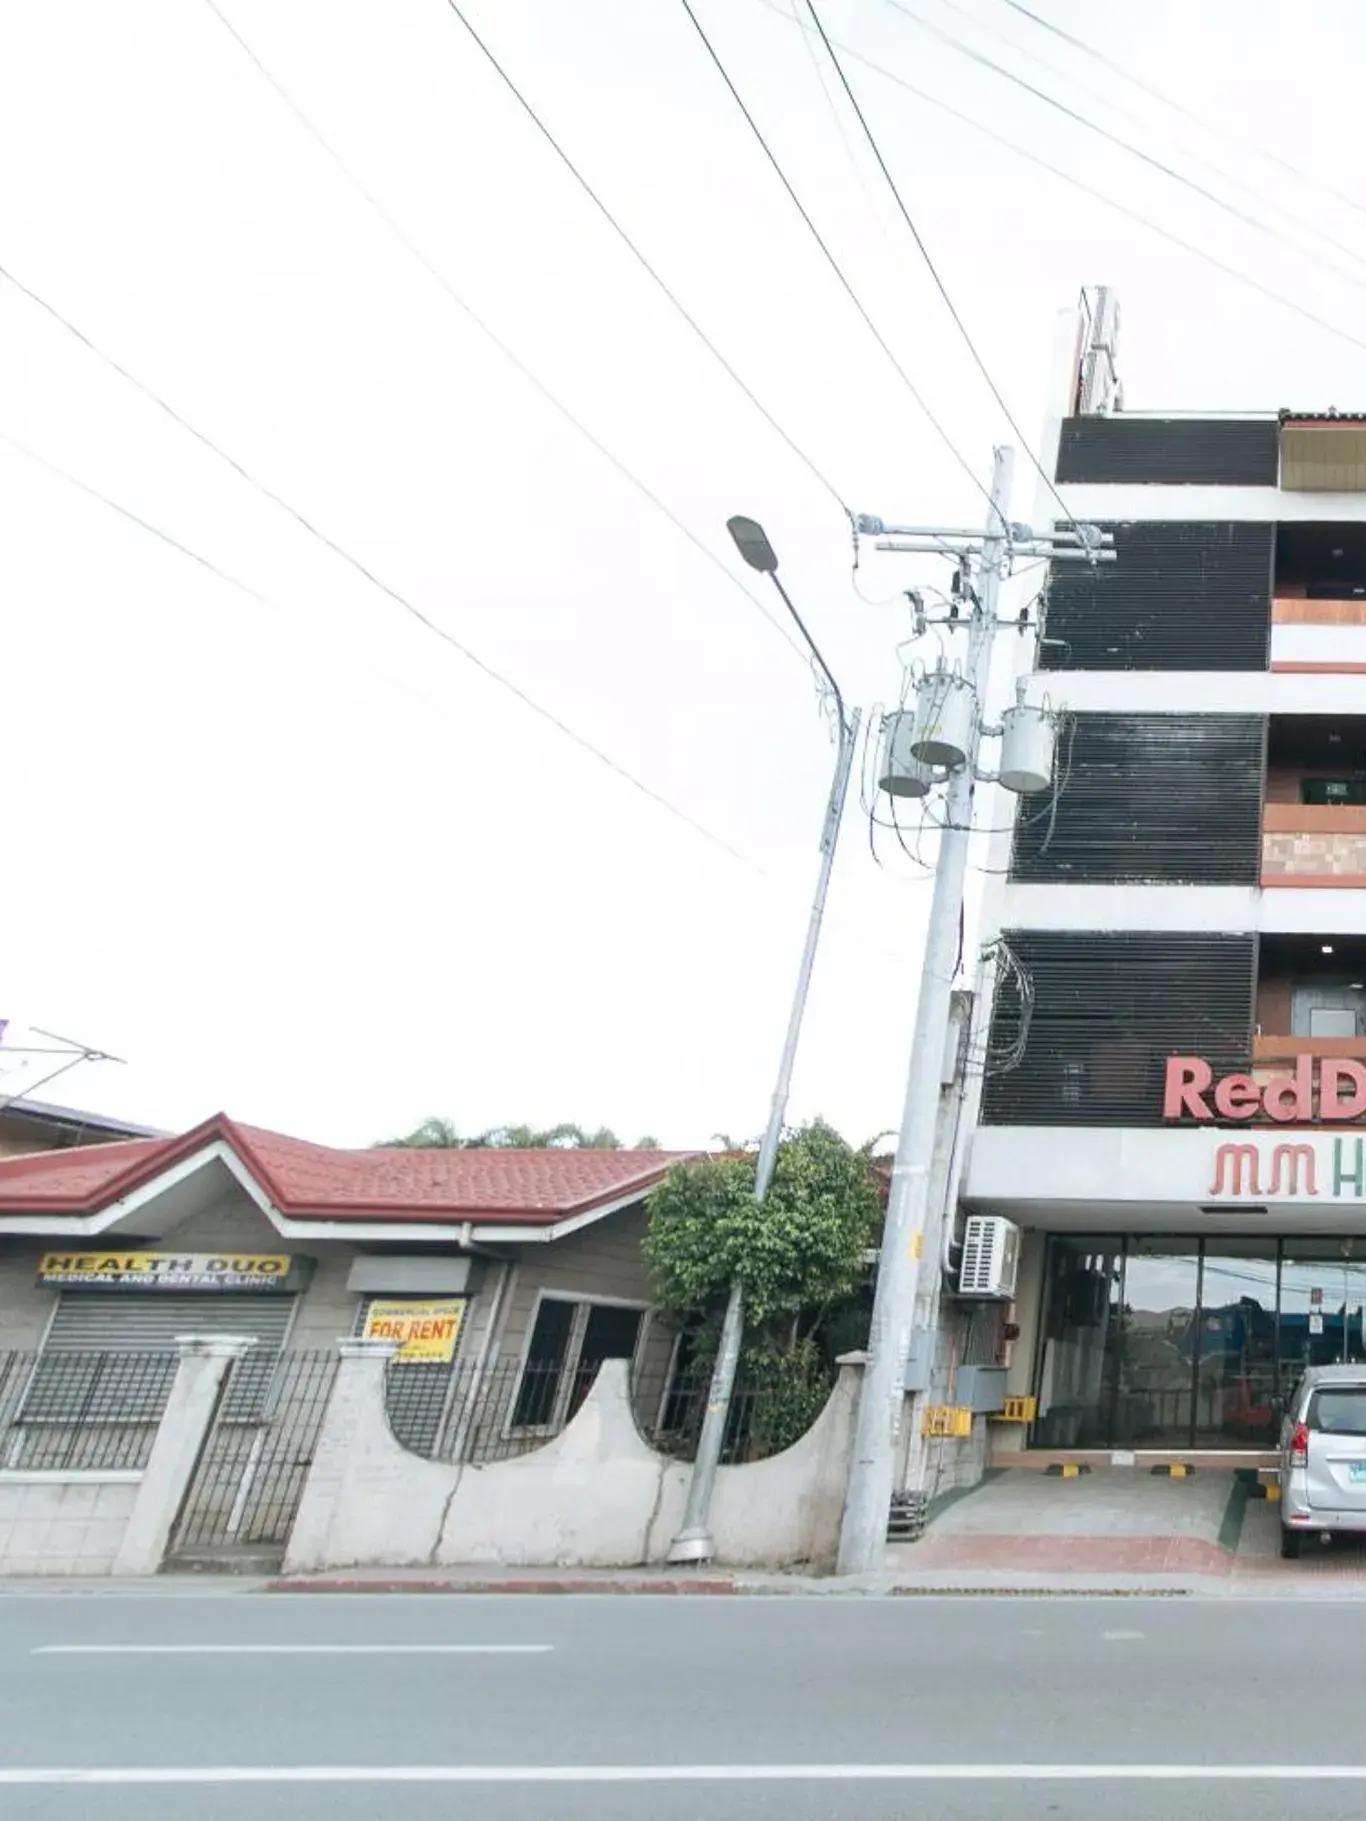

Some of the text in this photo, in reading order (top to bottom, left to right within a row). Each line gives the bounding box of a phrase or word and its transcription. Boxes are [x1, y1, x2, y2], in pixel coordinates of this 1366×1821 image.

[46, 1257, 283, 1274] HEALTH DUO
[43, 1271, 278, 1286] MEDICAL AND DENTAL CLINIC
[370, 1318, 457, 1341] FOR RENT
